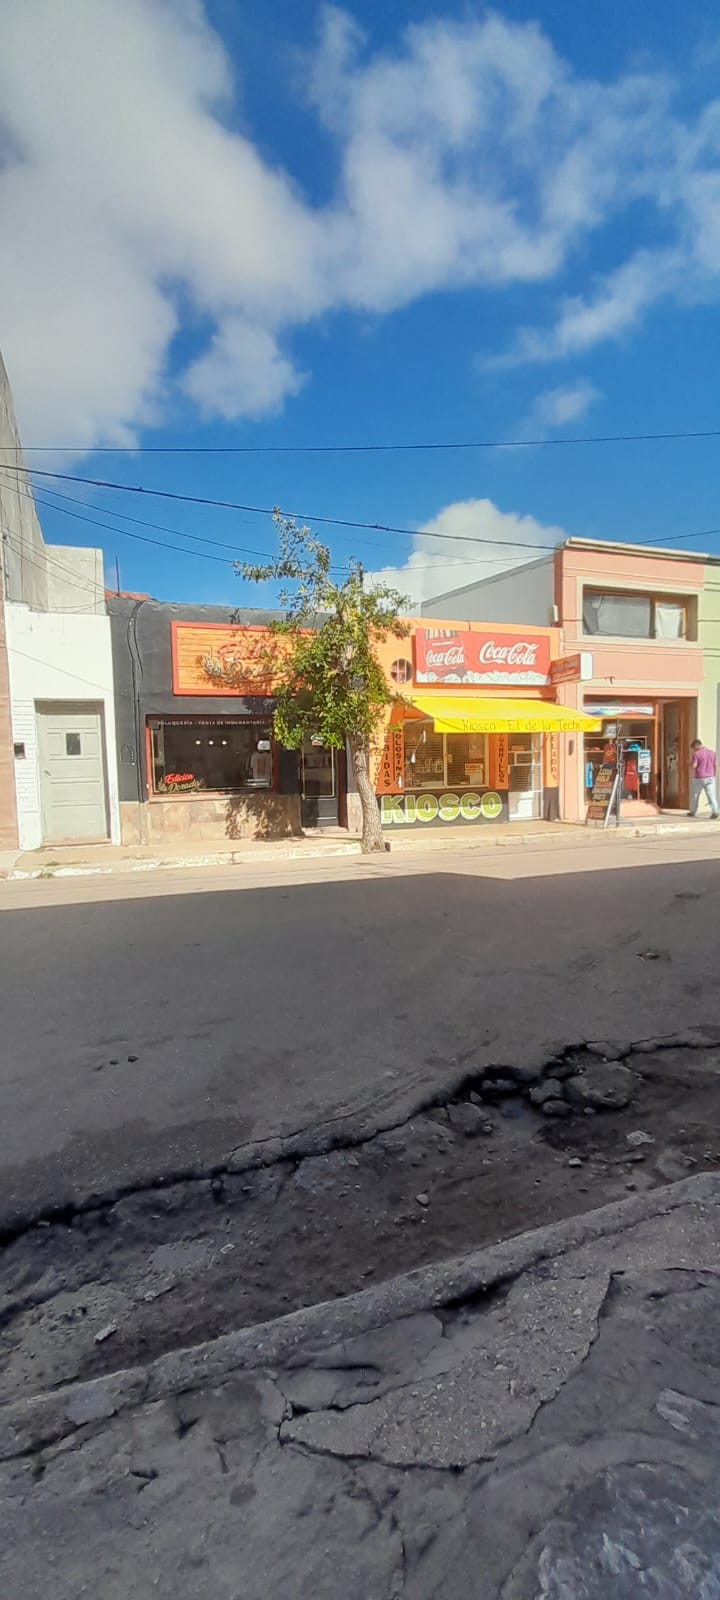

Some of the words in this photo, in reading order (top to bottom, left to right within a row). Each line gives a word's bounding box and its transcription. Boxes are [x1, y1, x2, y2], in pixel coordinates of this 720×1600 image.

[426, 645, 465, 668] Coca-Cola
[479, 640, 539, 666] Coca-Cola
[461, 718, 496, 731] Kiosco
[525, 719, 537, 731] de
[381, 792, 502, 824] KIOSCO
